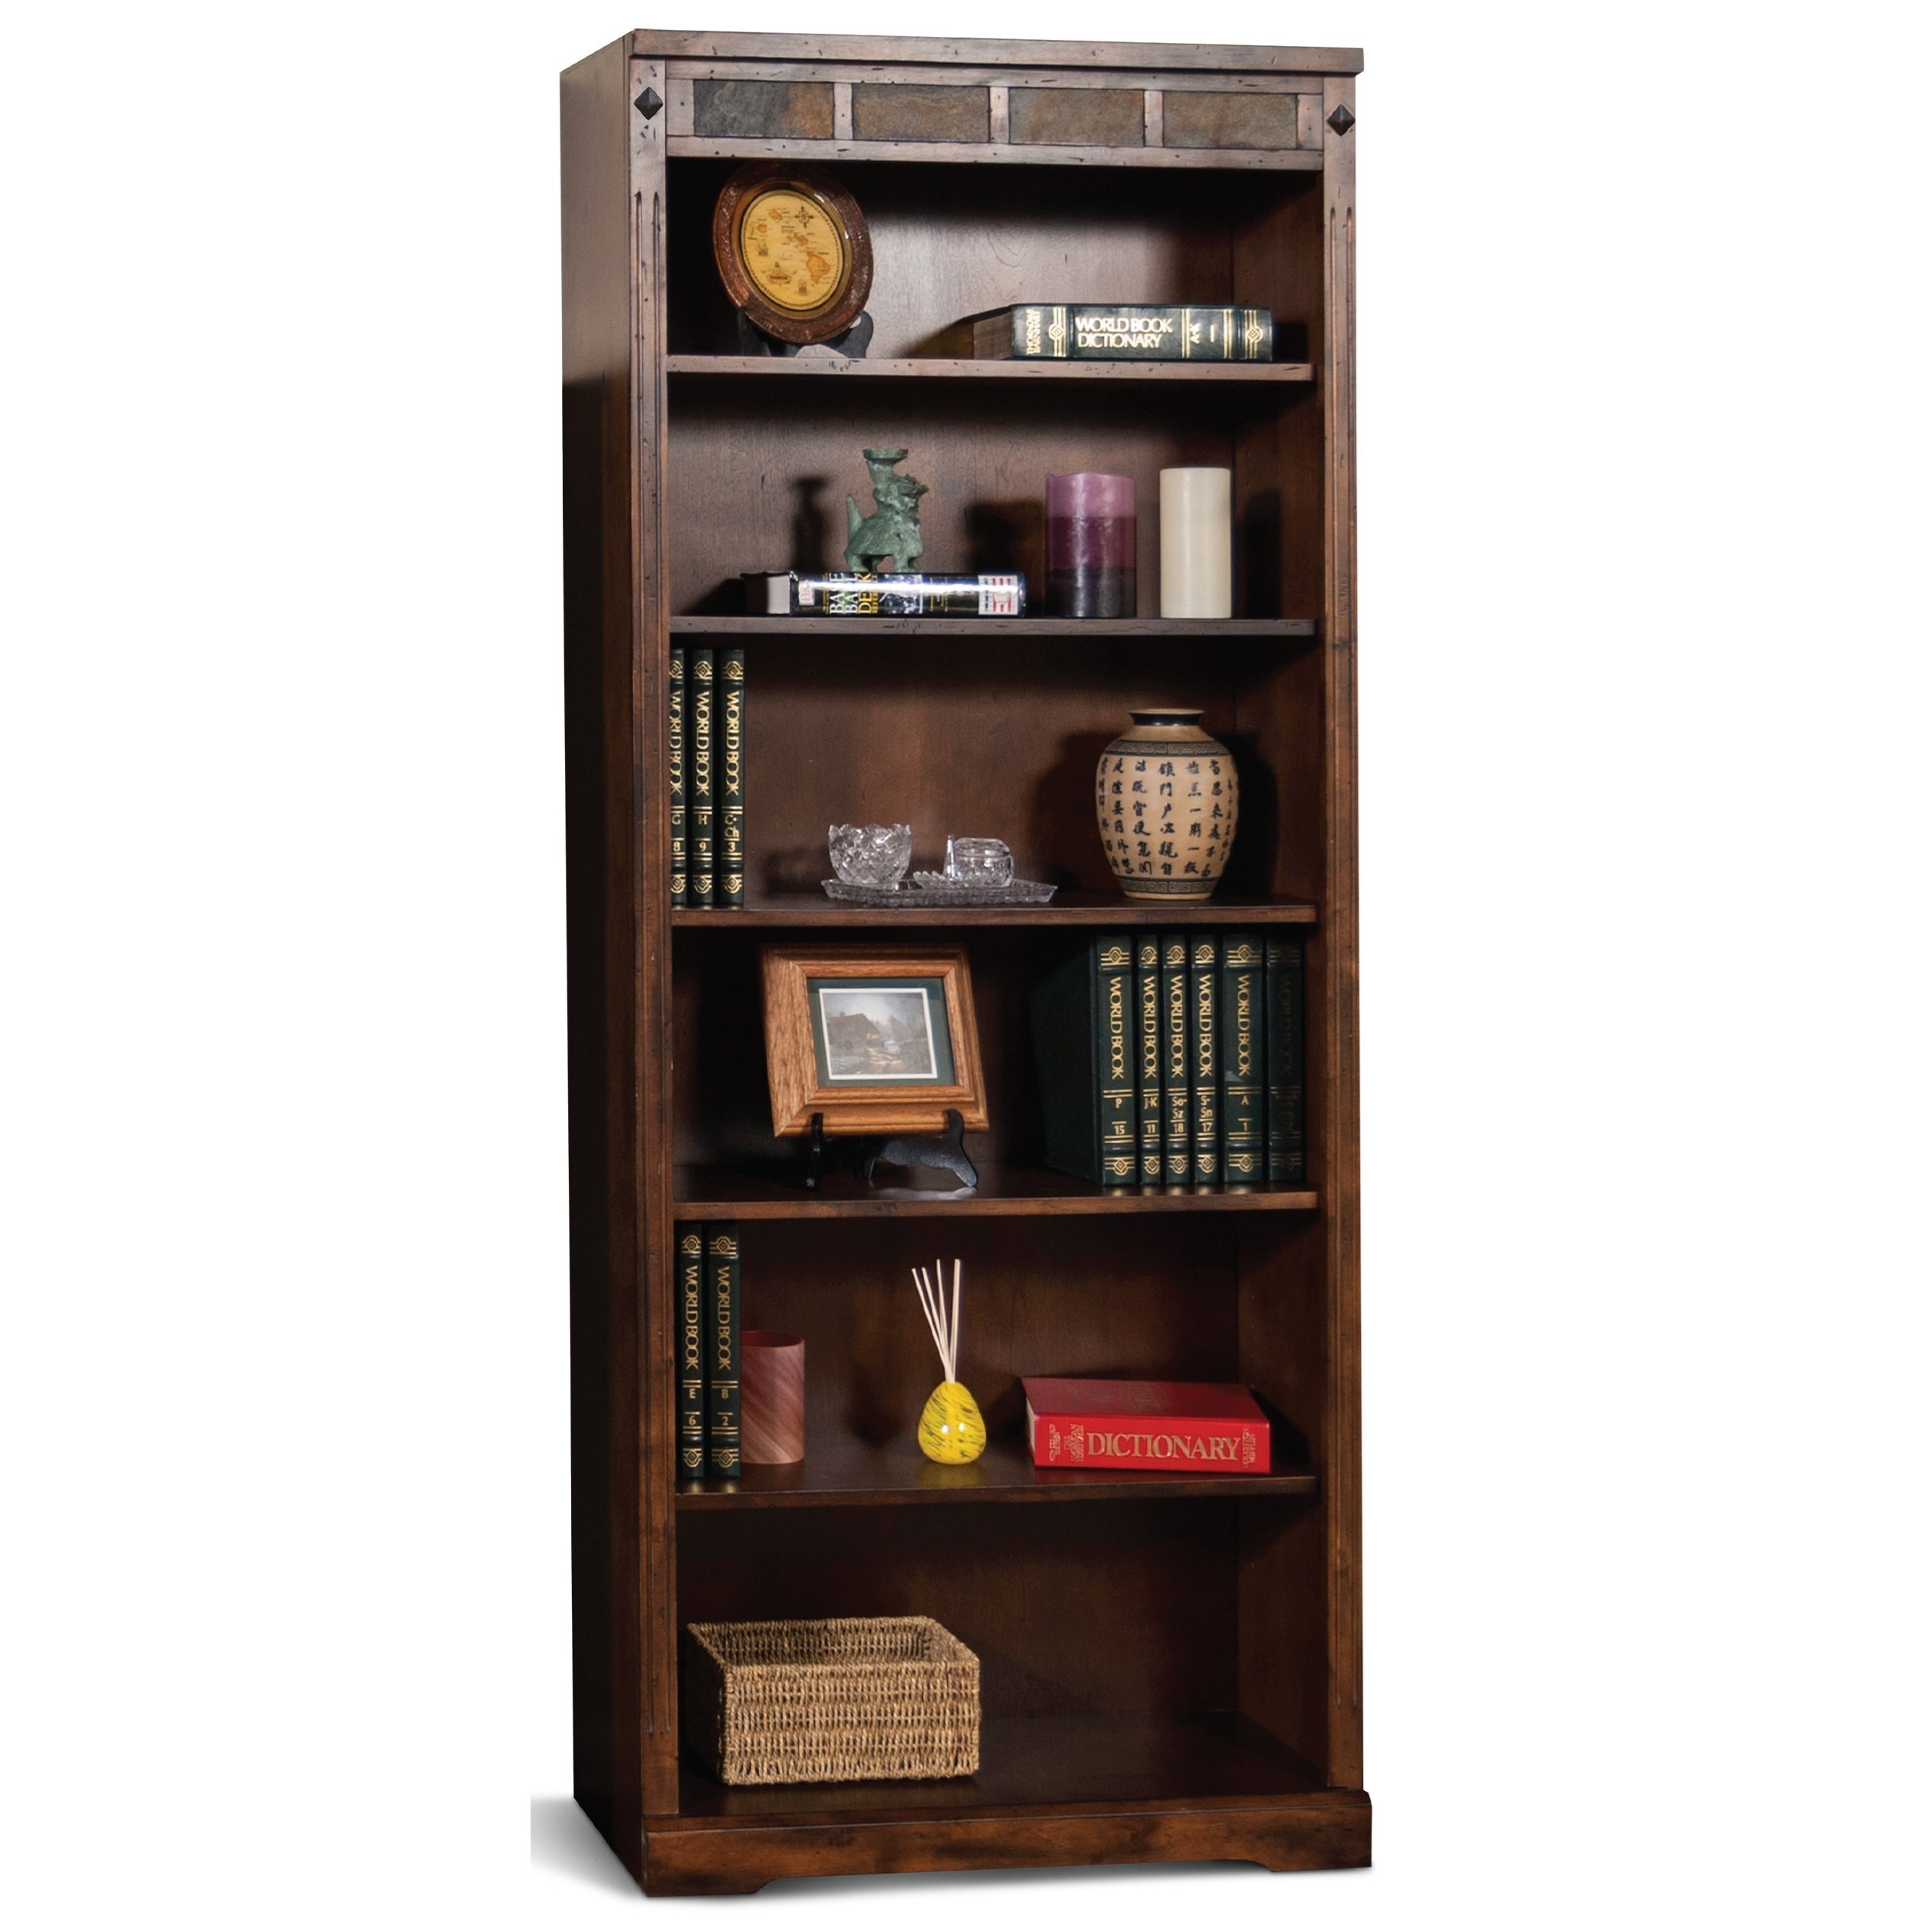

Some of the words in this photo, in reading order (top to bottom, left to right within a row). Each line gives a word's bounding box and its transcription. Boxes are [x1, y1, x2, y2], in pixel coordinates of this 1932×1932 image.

[1075, 317, 1130, 334] WORLD
[1130, 317, 1173, 334] BOOK
[1078, 333, 1163, 349] DICTIONARY
[845, 573, 858, 614] BAL
[858, 573, 872, 614] DEK
[669, 691, 682, 749] WORLD
[696, 691, 709, 750] WORLD
[726, 691, 739, 750] WORLD
[669, 751, 682, 796] BOOK
[696, 752, 709, 797] BOOK
[726, 752, 739, 796] BOOK
[672, 814, 681, 825] G
[698, 815, 708, 825] H
[724, 826, 740, 838] Ch
[673, 842, 681, 852] 8
[699, 842, 707, 852] 9
[728, 842, 736, 852] 3
[1110, 977, 1122, 1034] WORLD
[1143, 976, 1156, 1033] WORLD
[1171, 975, 1183, 1032] WORLD
[1199, 974, 1211, 1031] WORLD
[1237, 974, 1250, 1031] WORLD
[1111, 1036, 1124, 1079] BOOK
[1144, 1035, 1156, 1079] BOOK
[1171, 1034, 1184, 1078] BOOK
[1199, 1033, 1212, 1077] BOOK
[1238, 1033, 1250, 1076] BOOK
[1116, 1098, 1122, 1109] P
[1172, 1109, 1184, 1119] Sz
[1201, 1107, 1213, 1118] Sn
[1240, 1096, 1250, 1105] A
[1114, 1125, 1125, 1135] 15
[1146, 1124, 1155, 1133] 11
[1174, 1123, 1184, 1133] 18
[1201, 1122, 1213, 1132] 17
[1243, 1122, 1247, 1131] 1
[685, 1265, 698, 1323] WORLD
[718, 1266, 730, 1324] WORLD
[685, 1325, 699, 1370] BOOK
[718, 1326, 731, 1370] BOOK
[689, 1388, 696, 1398] E
[721, 1388, 728, 1399] B
[688, 1415, 696, 1425] 6
[722, 1416, 729, 1425] 2
[1087, 1432, 1240, 1460] DICTIONARY
